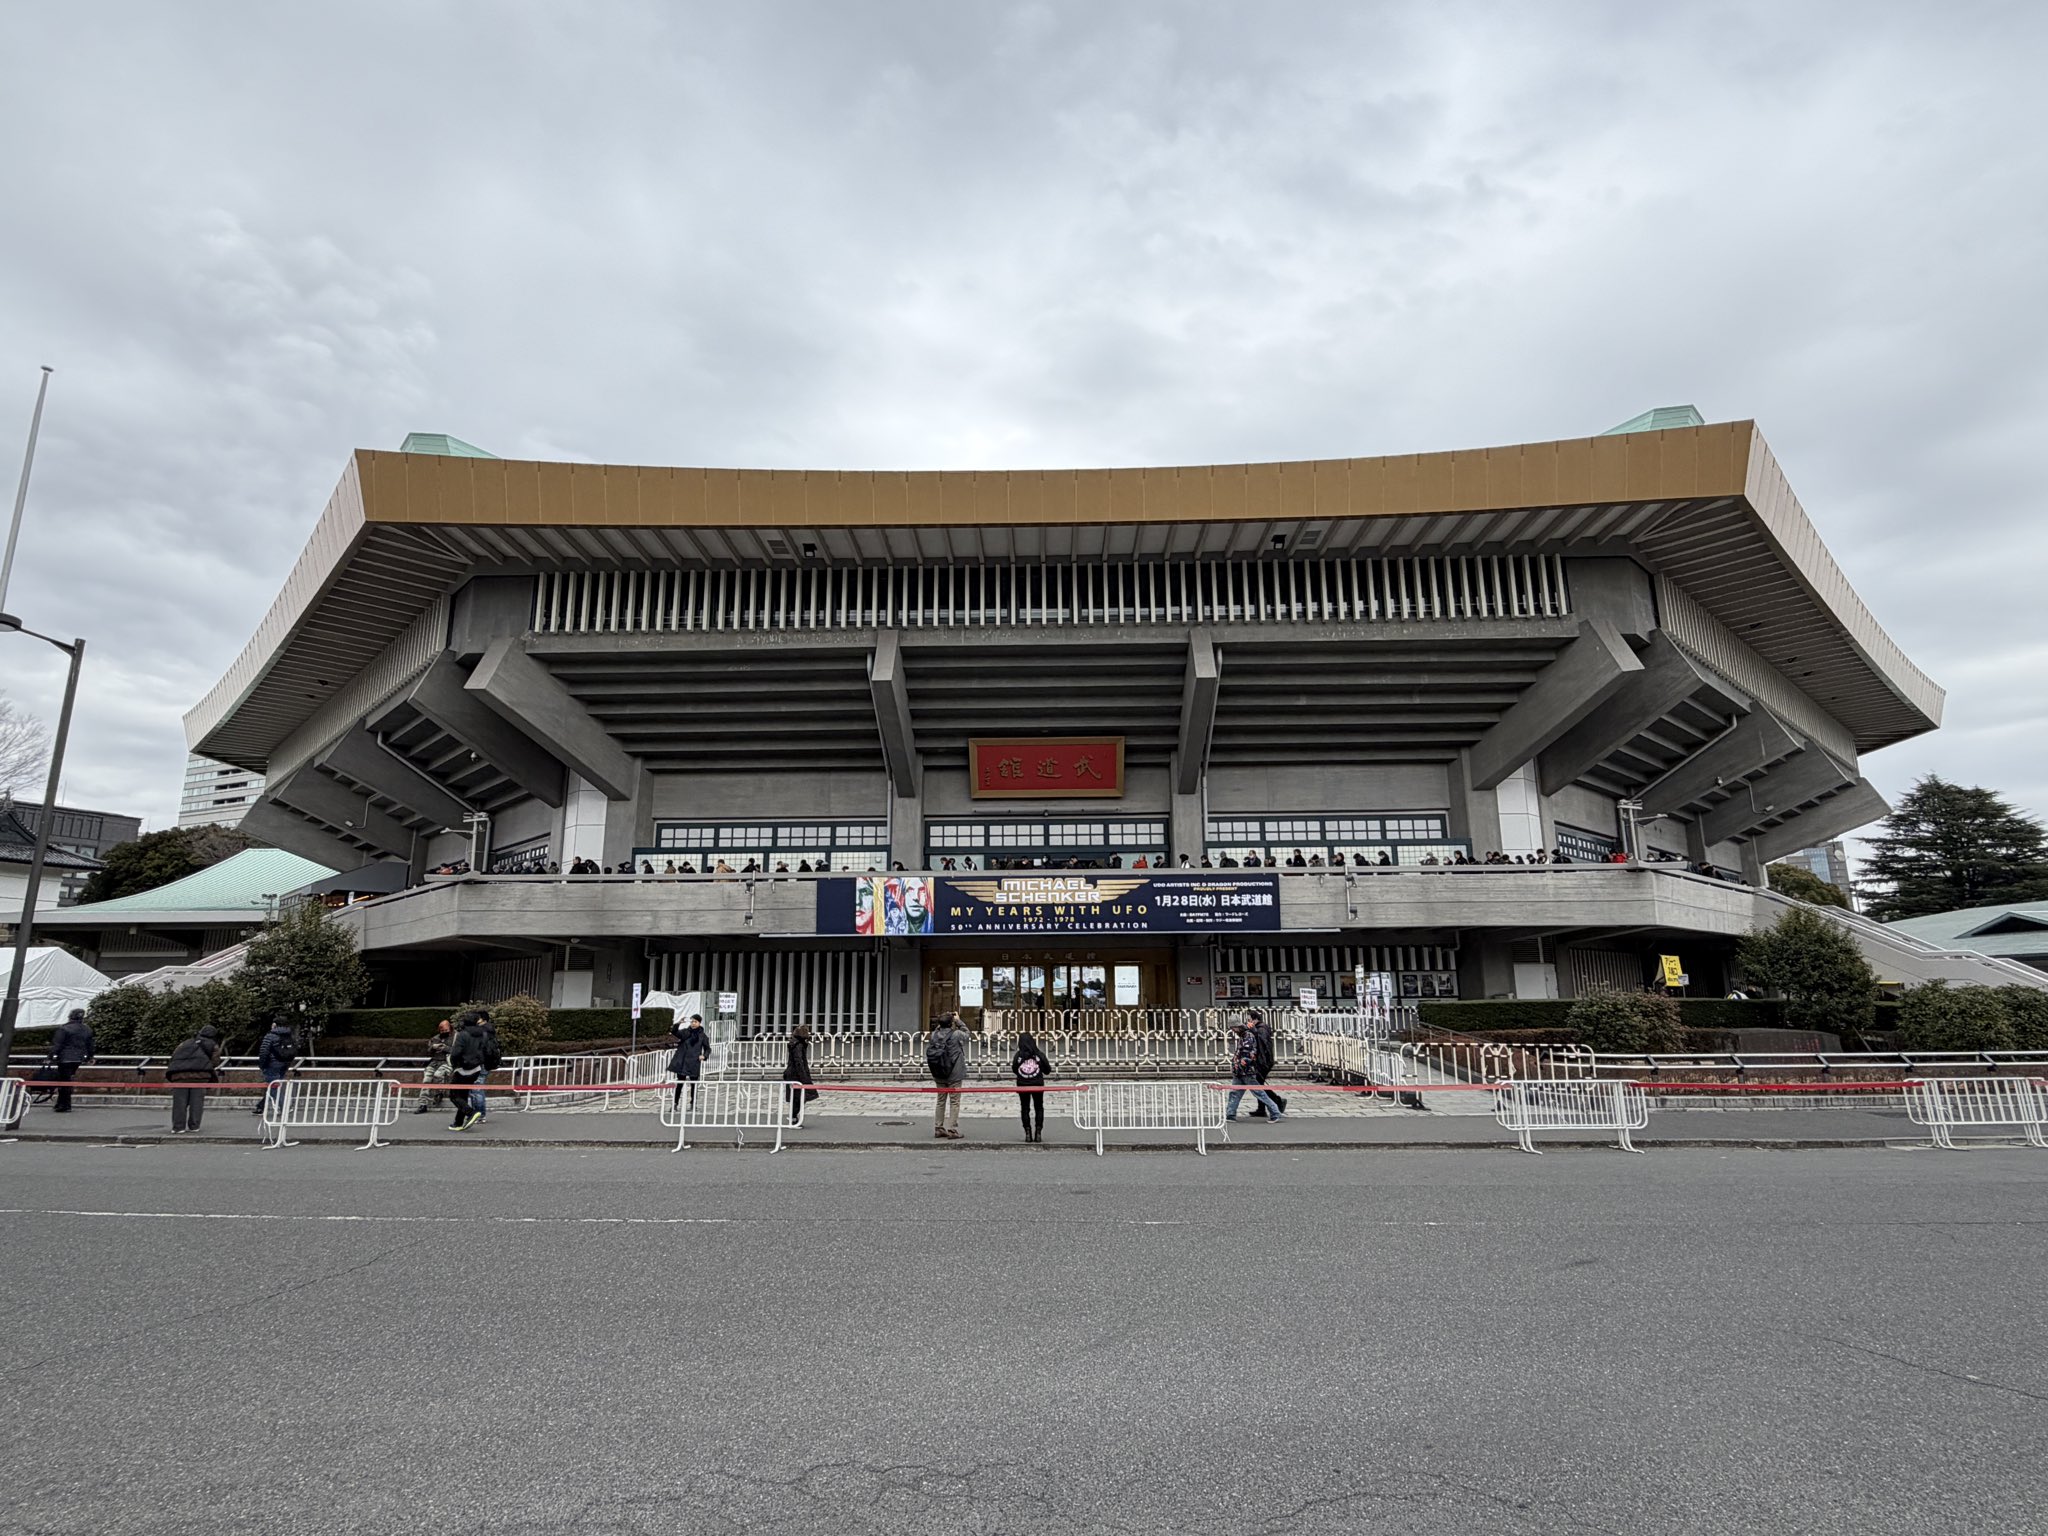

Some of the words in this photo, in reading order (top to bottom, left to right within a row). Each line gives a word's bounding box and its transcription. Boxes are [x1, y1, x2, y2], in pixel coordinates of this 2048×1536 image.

[1004, 879, 1093, 891] MICHAEL
[995, 892, 1100, 902] SCHENKER
[1154, 894, 1216, 907] 1月28日(水)
[1221, 893, 1273, 907] 日本武道館
[950, 906, 974, 917] MY
[985, 906, 1043, 917] YEARS
[1054, 905, 1100, 915] WITH
[1112, 904, 1147, 915] UFO
[977, 922, 1060, 930] ANNIVERSARY
[1067, 921, 1148, 930] CELEBRATION
